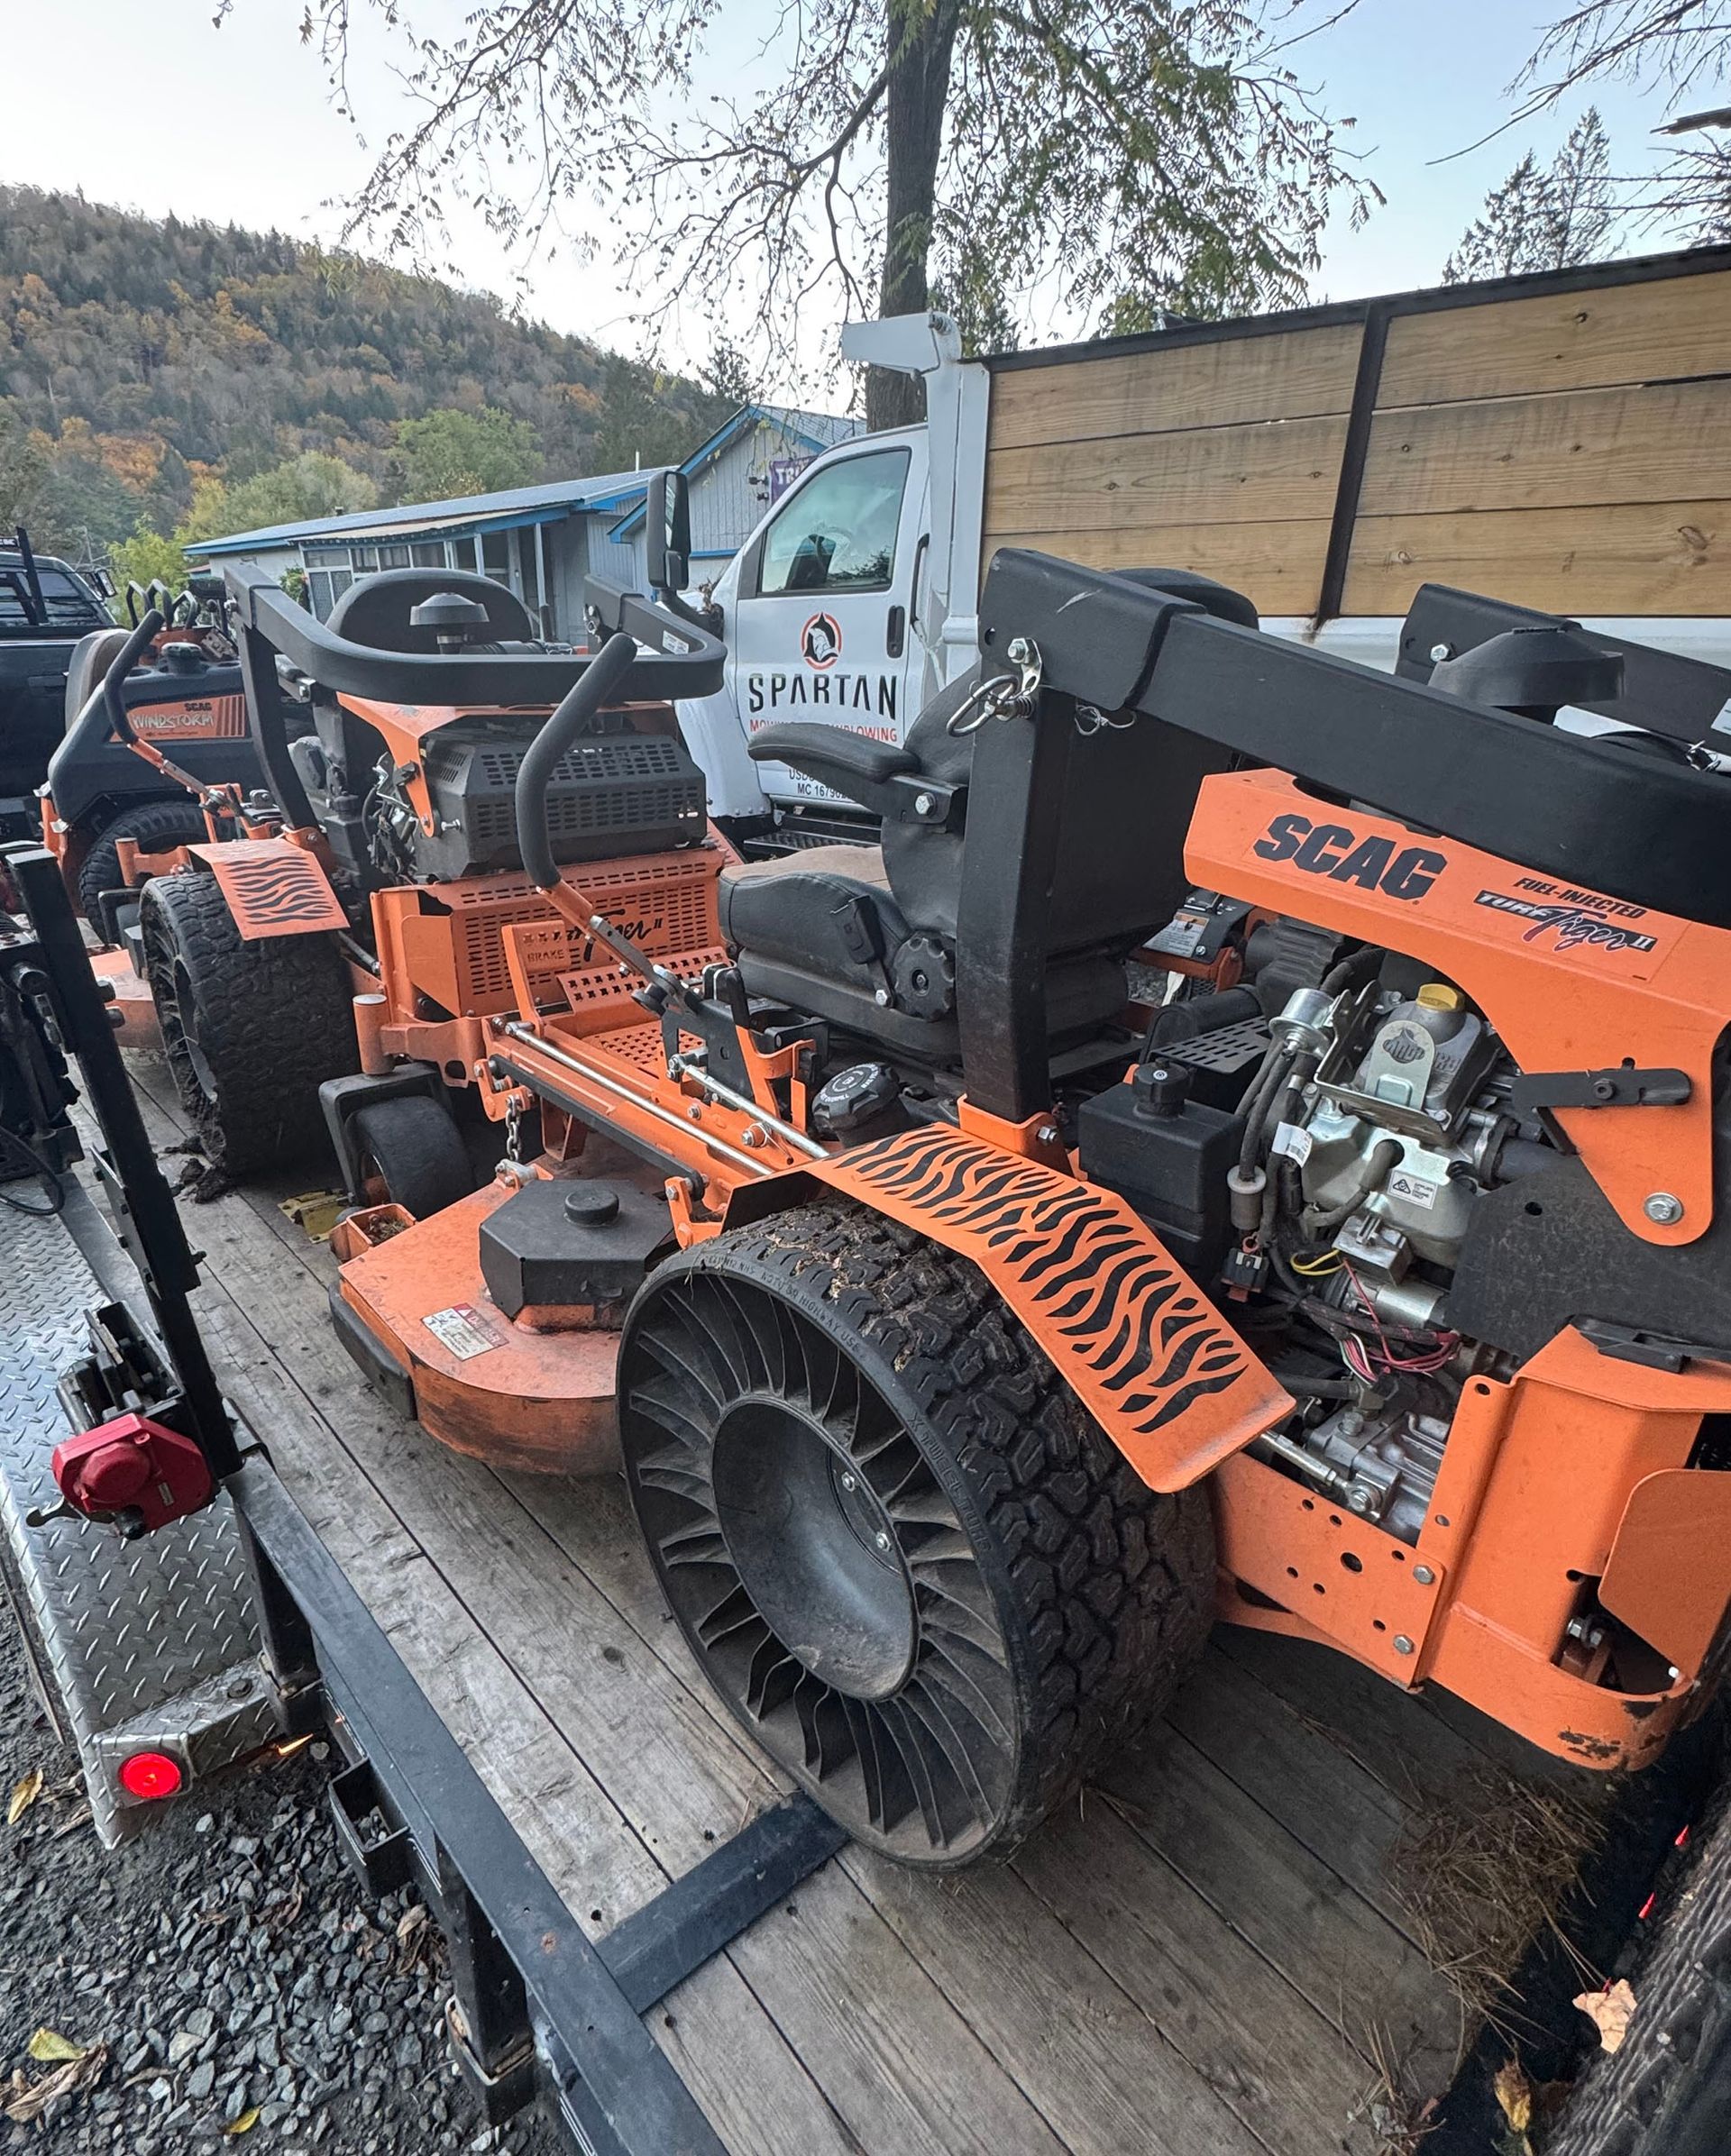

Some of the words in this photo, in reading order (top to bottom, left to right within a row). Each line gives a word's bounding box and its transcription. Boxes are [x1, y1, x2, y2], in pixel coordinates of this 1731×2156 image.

[185, 702, 212, 711] SCAG
[748, 673, 898, 720] SPARTAN
[133, 713, 215, 728] WINDSTORM
[789, 769, 814, 781] USD
[797, 783, 811, 795] MC
[1253, 814, 1448, 900] SCAG
[1513, 877, 1647, 919] FUEL-INJECTED
[1477, 892, 1553, 918] TURF
[1522, 904, 1626, 952] Tiger
[527, 949, 564, 964] BRAKE
[801, 1294, 840, 1331] HIGHWAY
[840, 1330, 860, 1351] USE
